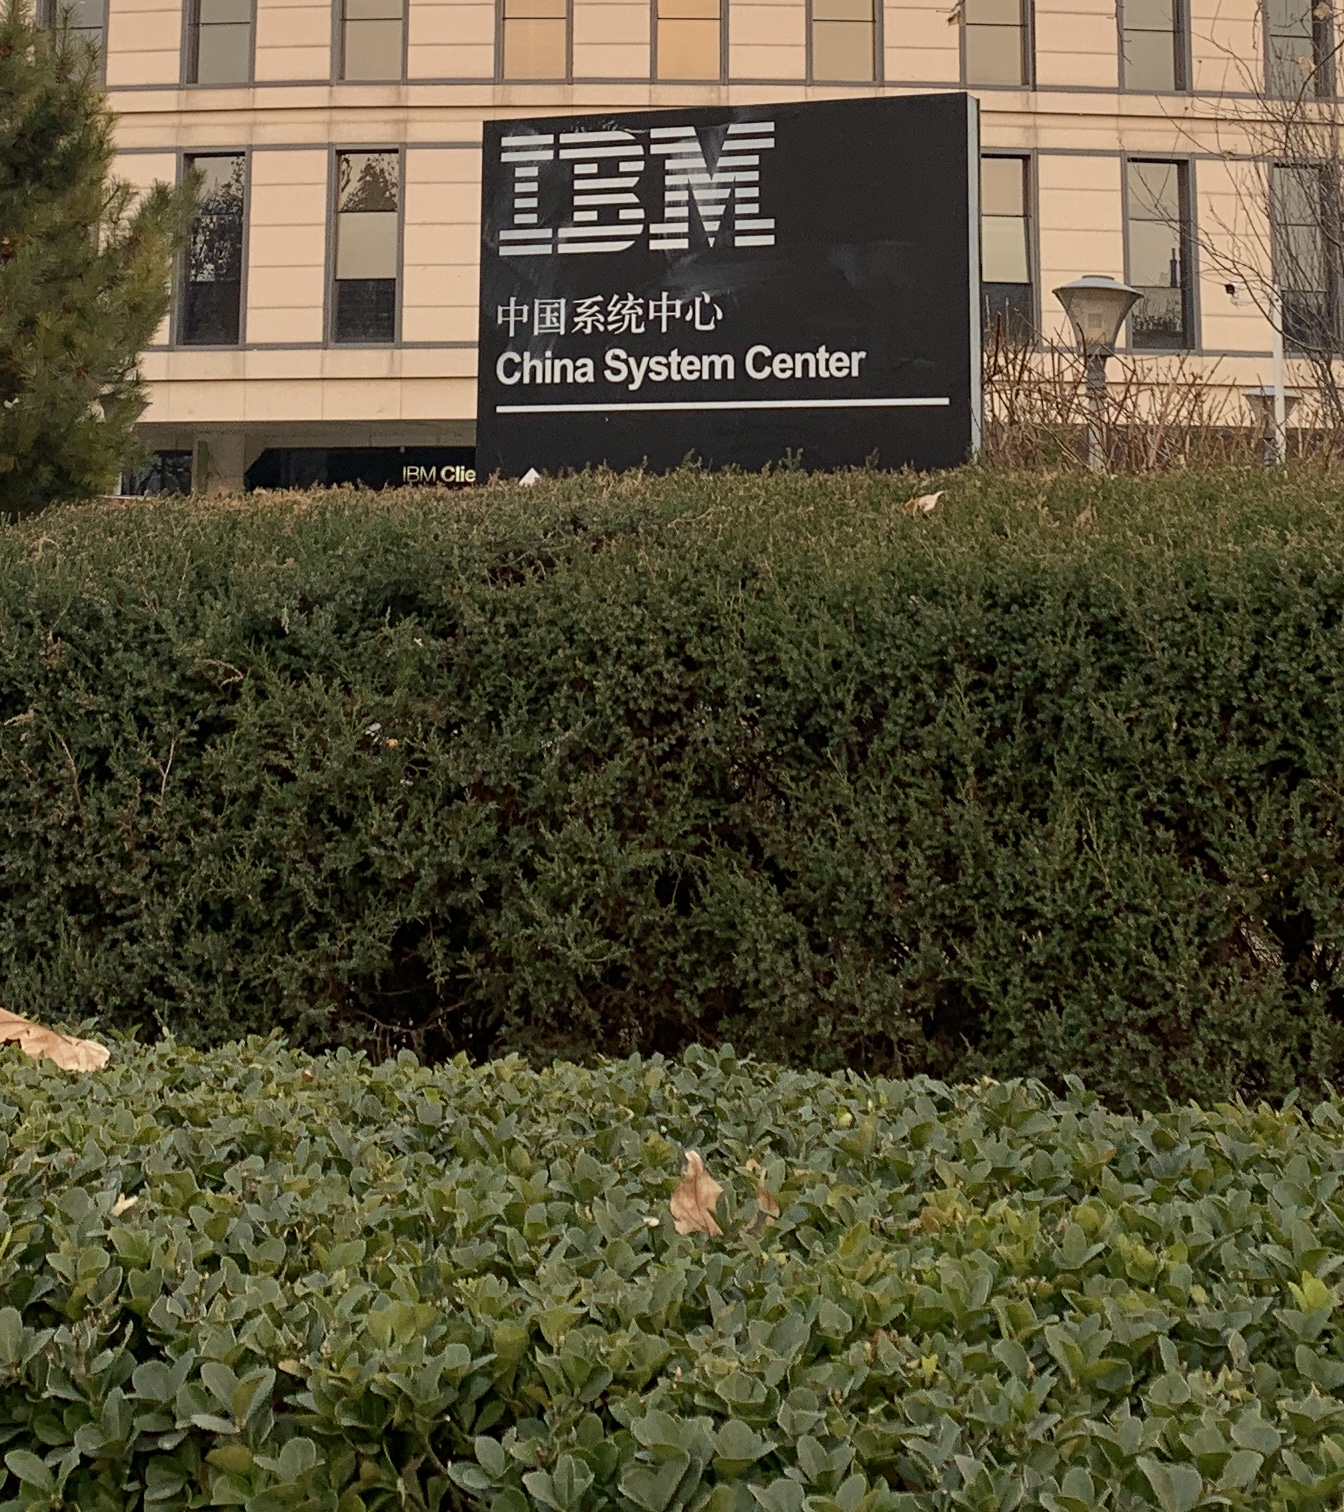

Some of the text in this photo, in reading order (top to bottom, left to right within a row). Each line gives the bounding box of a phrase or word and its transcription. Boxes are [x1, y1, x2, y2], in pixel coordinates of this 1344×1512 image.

[499, 121, 775, 255] IBM
[497, 291, 724, 337] 中国系统中心
[496, 345, 866, 390] China System Center
[402, 465, 476, 483] IBM Clie
